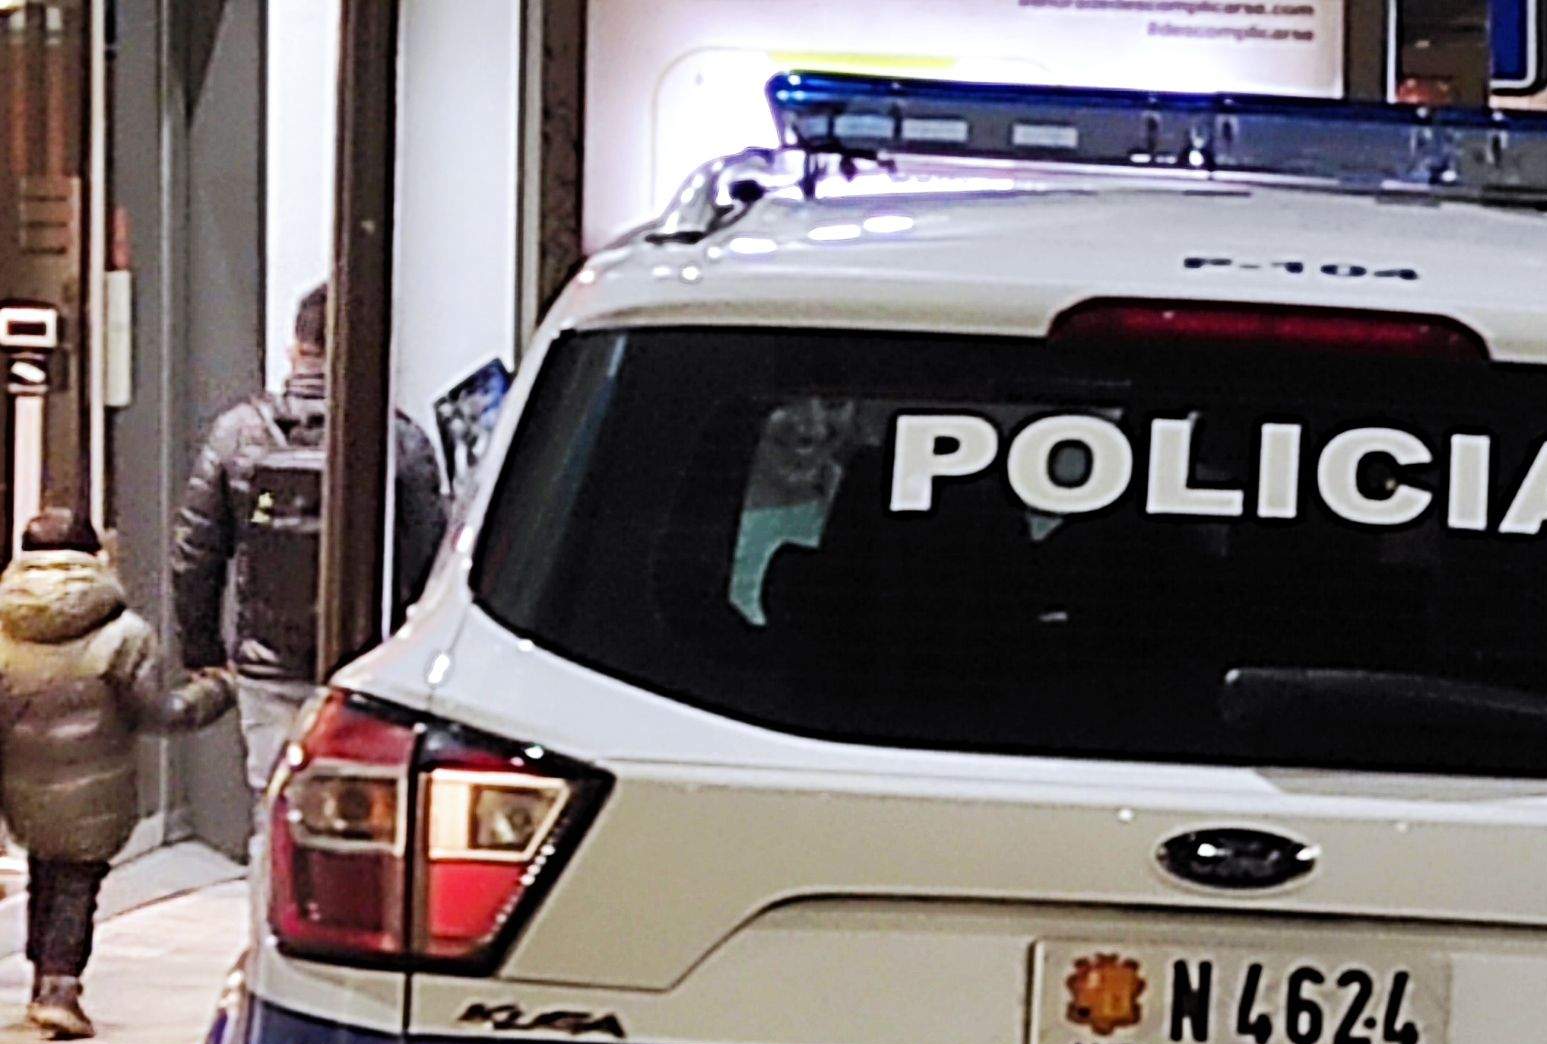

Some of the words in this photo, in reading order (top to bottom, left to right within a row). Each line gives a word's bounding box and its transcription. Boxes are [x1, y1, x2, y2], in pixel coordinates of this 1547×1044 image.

[1183, 256, 1419, 281] P-104
[1169, 959, 1213, 1043] N
[458, 1003, 626, 1039] KUGA
